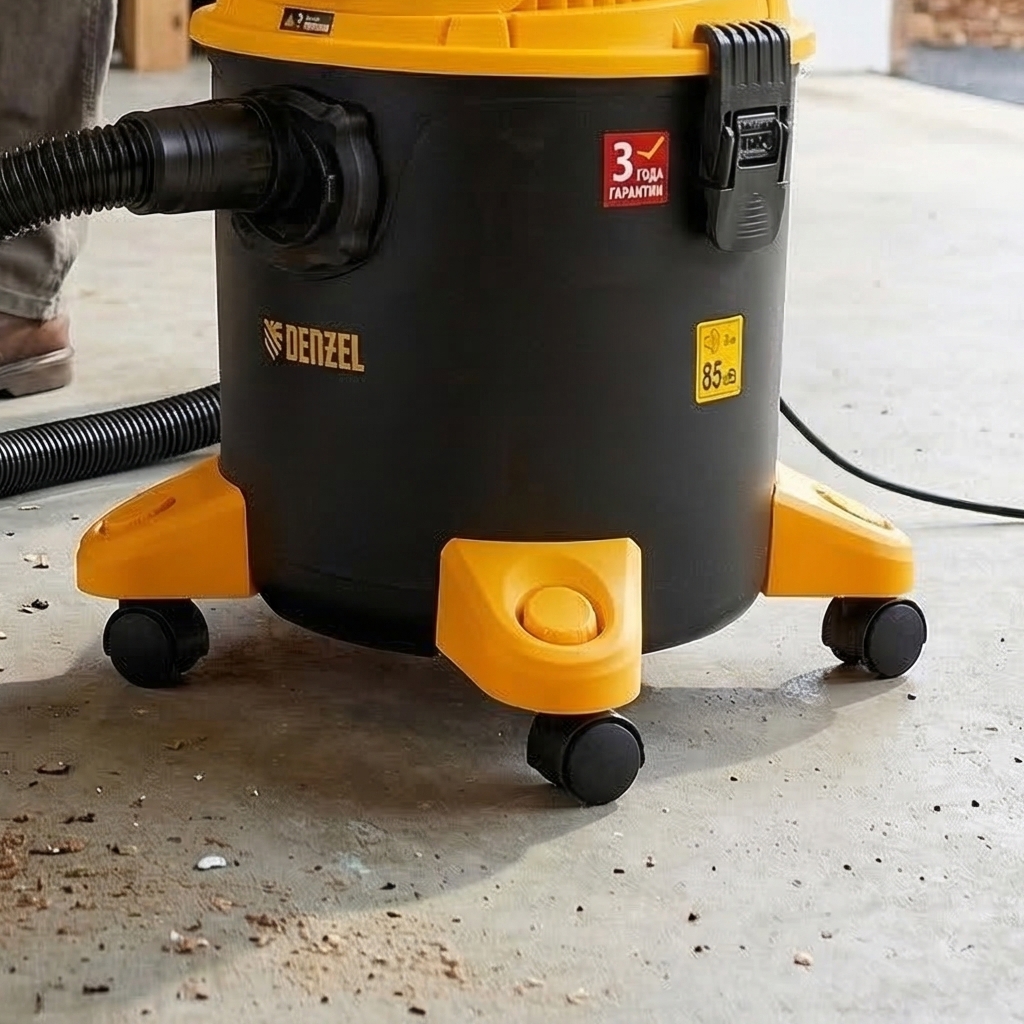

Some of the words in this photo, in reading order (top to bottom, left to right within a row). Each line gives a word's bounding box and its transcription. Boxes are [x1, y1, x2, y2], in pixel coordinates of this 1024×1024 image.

[613, 142, 633, 182] 3
[637, 168, 663, 183] ГОДА
[609, 185, 663, 200] ГАРАНТИИ
[286, 324, 364, 371] DENZEL
[703, 360, 722, 390] 85
